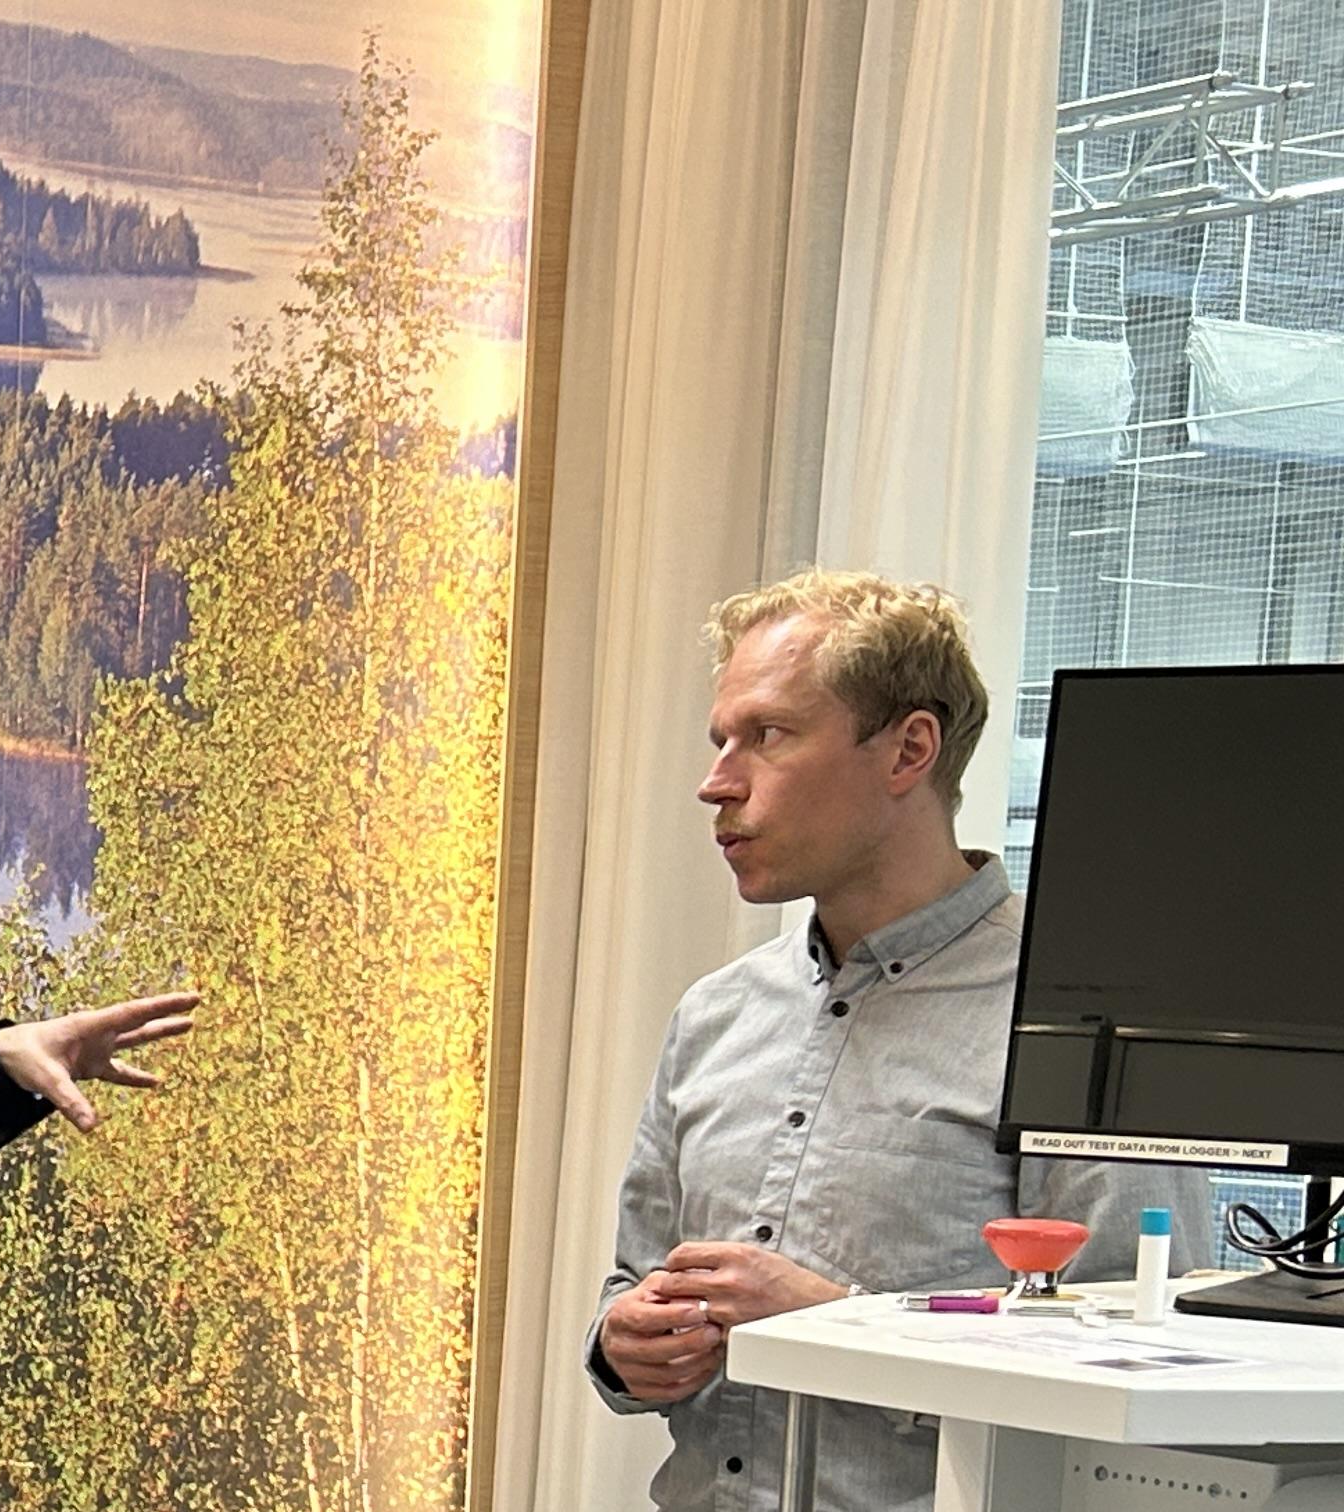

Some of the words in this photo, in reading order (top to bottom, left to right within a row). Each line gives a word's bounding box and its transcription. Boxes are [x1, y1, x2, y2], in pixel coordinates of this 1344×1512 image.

[1032, 1137, 1062, 1148] READ
[1063, 1139, 1086, 1149] OUT
[1087, 1140, 1116, 1151] TEST
[1118, 1142, 1147, 1153] DATA
[1148, 1143, 1180, 1154] FROM
[1182, 1145, 1230, 1157] LOGGER
[1242, 1148, 1272, 1159] NEXT
